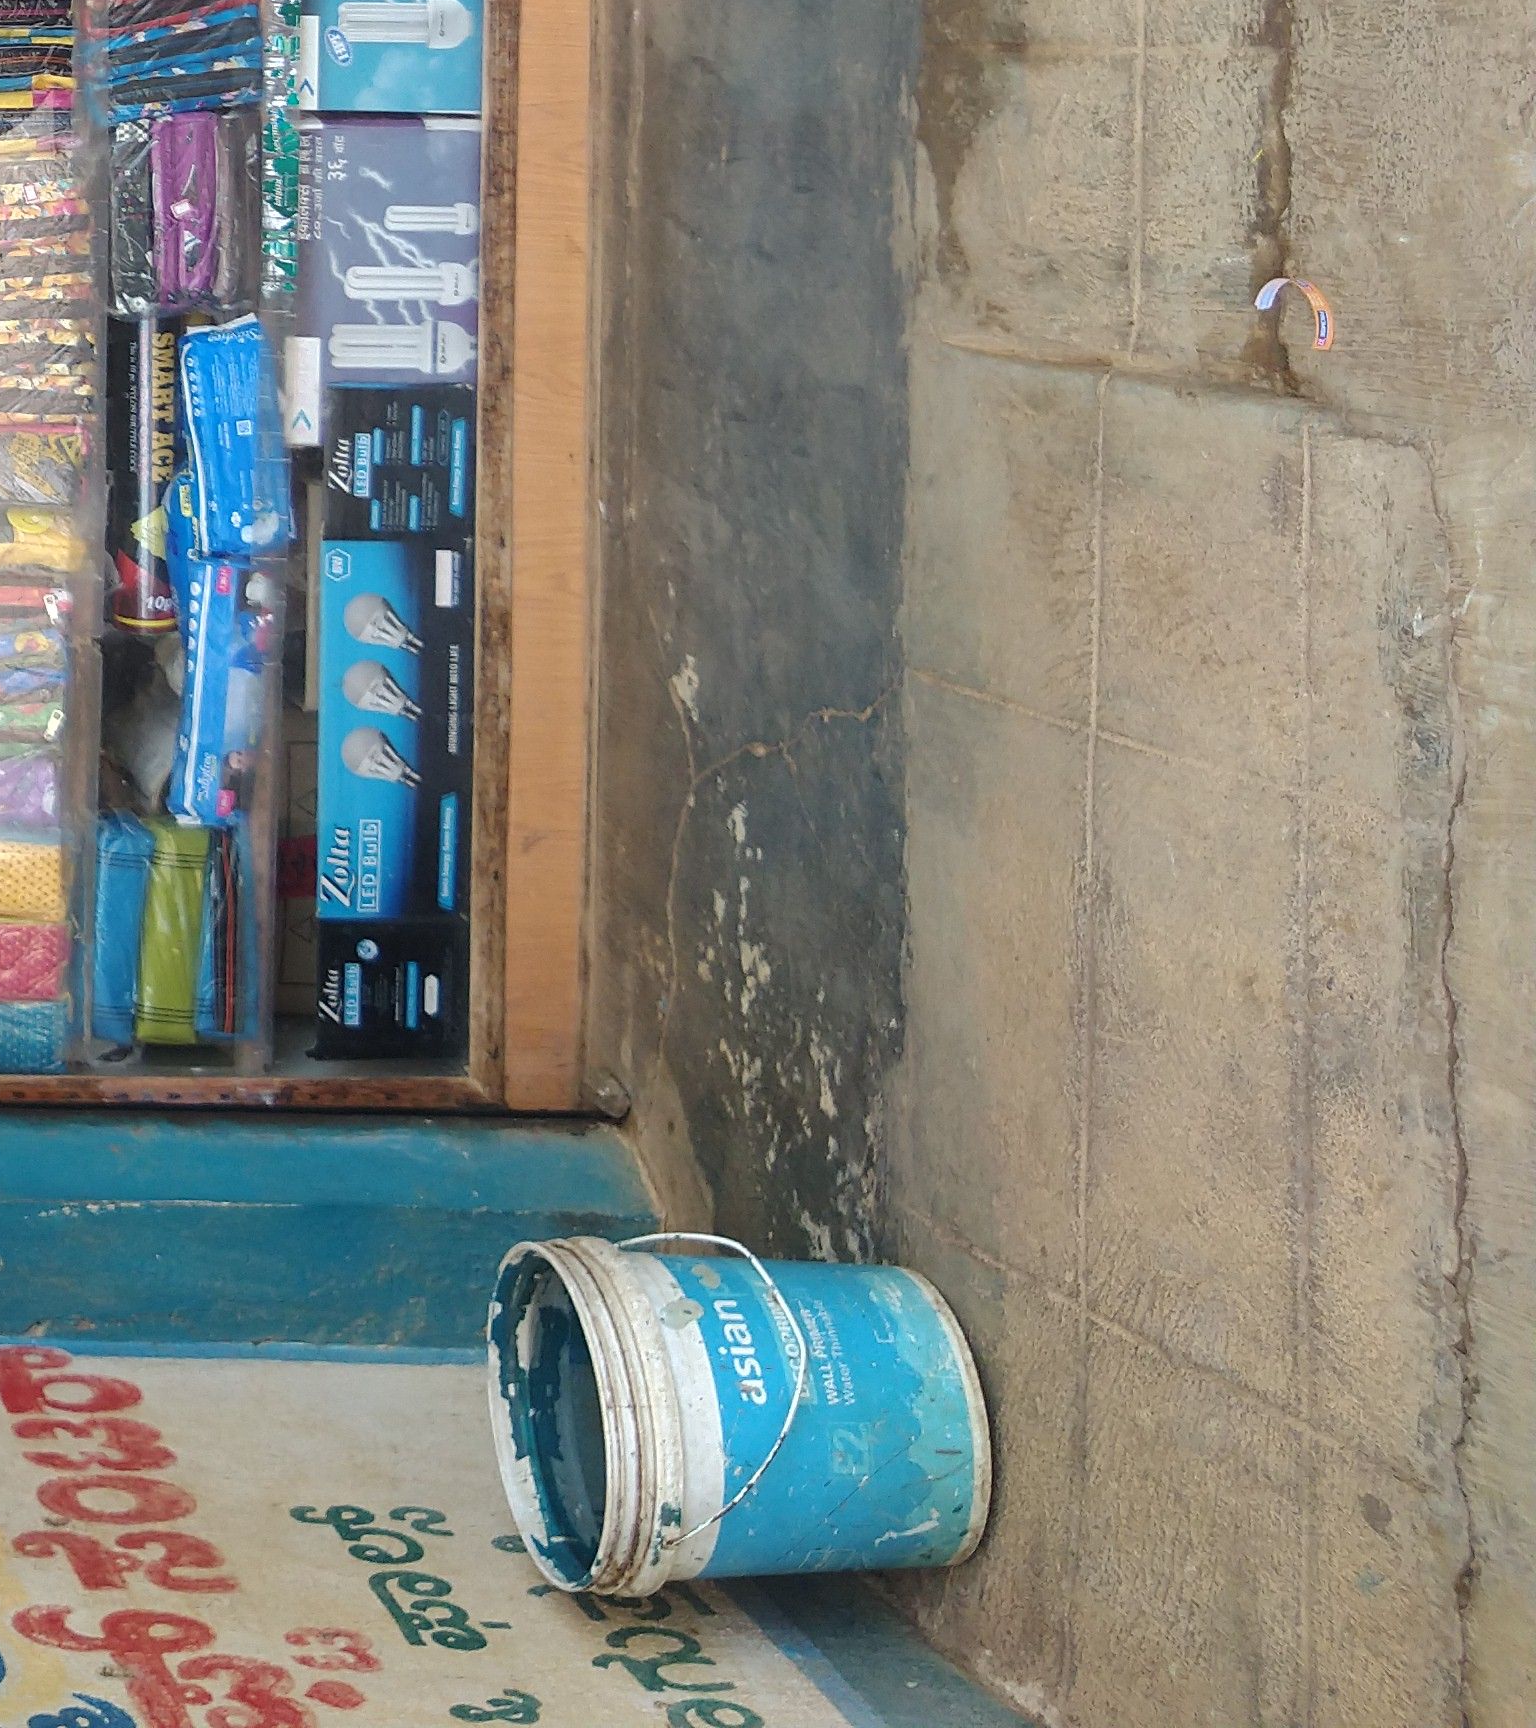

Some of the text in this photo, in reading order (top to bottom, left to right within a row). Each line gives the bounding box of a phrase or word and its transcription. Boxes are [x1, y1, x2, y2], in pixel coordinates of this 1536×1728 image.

[150, 331, 176, 485] SMART ACE
[327, 437, 353, 495] Zolta
[355, 434, 368, 495] LED Bulb
[318, 826, 354, 907] Zolta
[360, 822, 379, 909] LED Bulb
[317, 968, 342, 1024] Zolta
[345, 963, 359, 1024] LED Bulb
[712, 1299, 768, 1406] asian
[818, 1363, 840, 1406] WALL
[838, 1361, 856, 1406] Water
